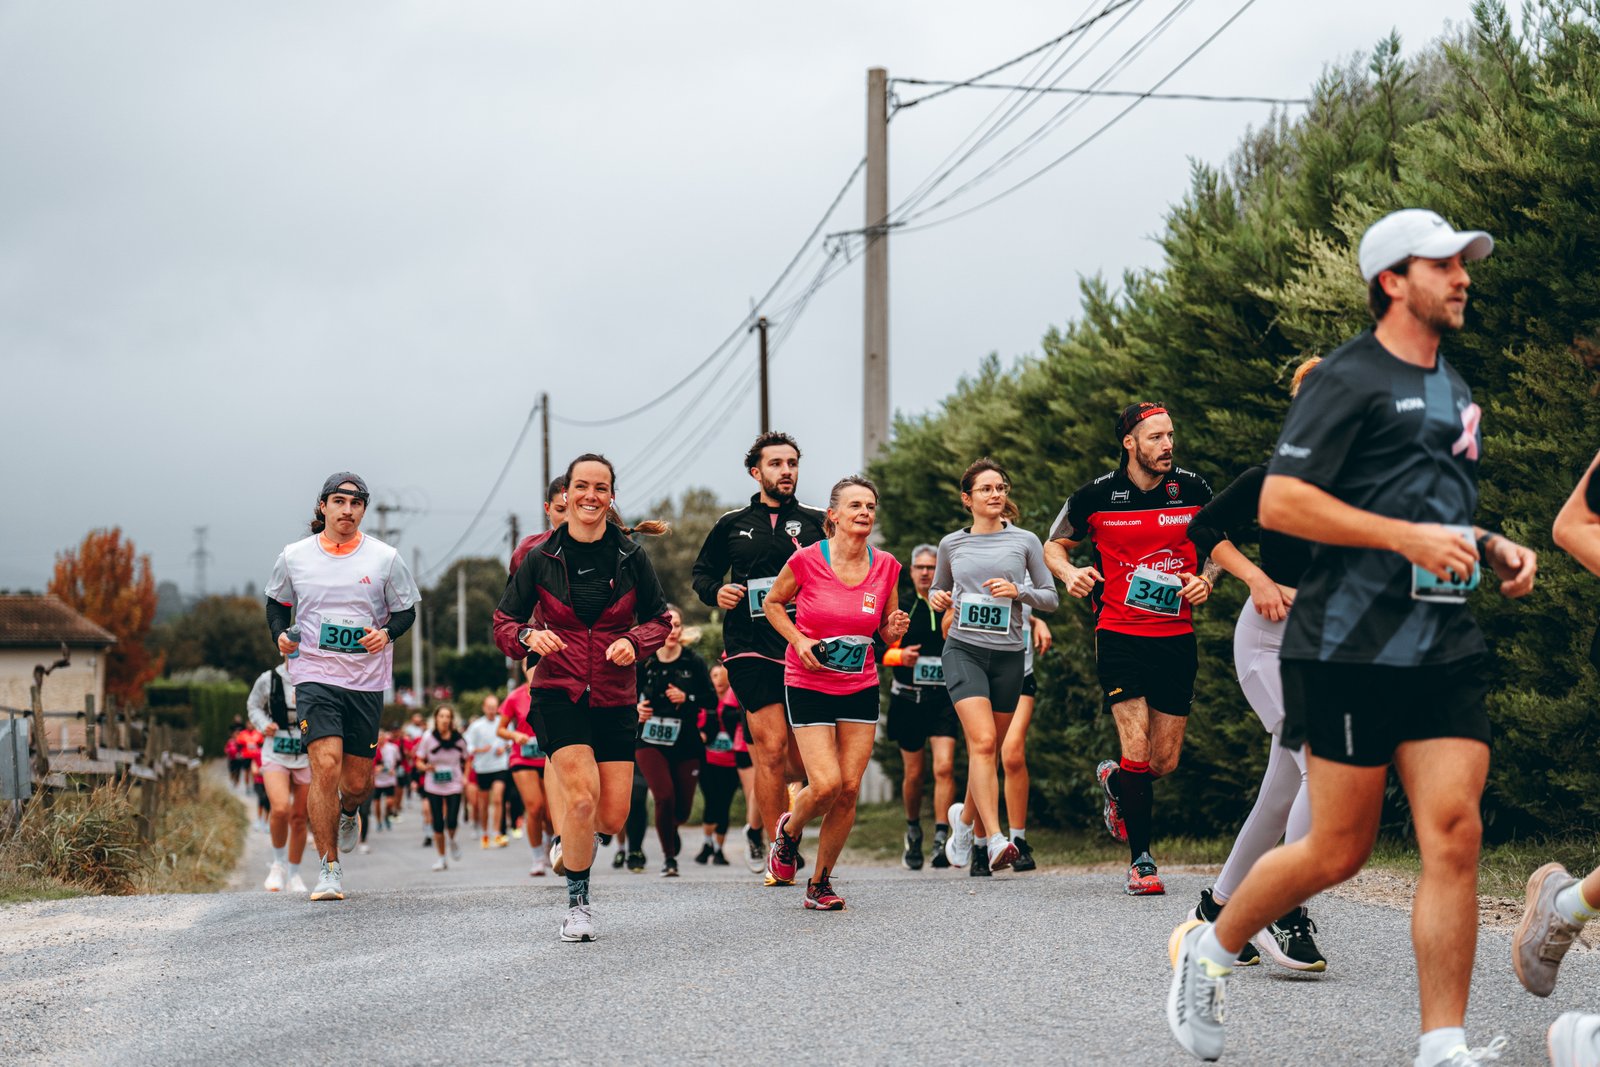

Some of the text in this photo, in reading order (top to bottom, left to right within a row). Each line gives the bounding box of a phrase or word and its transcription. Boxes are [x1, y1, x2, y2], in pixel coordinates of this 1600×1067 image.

[1135, 580, 1177, 606] 340
[968, 604, 1002, 626] 693
[325, 626, 364, 647] 309
[828, 641, 863, 665] 279
[921, 665, 943, 679] 628
[649, 724, 673, 740] 688
